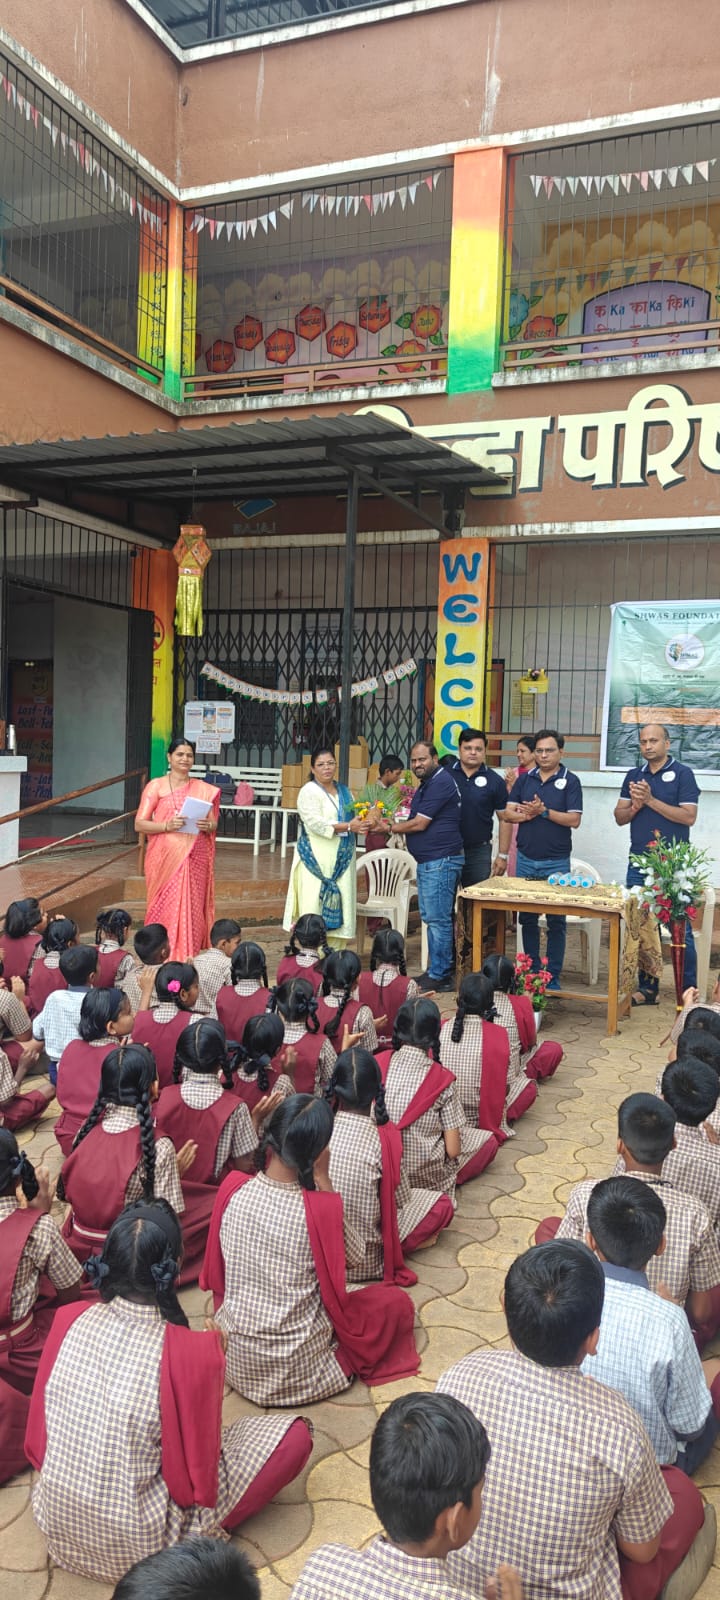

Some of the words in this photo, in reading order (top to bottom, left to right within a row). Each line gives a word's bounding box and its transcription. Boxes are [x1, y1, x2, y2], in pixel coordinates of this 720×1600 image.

[594, 305, 606, 317] क
[610, 304, 625, 316] Ka
[629, 300, 647, 315] का
[649, 300, 662, 312] Ka
[635, 612, 669, 620] SHWAS
